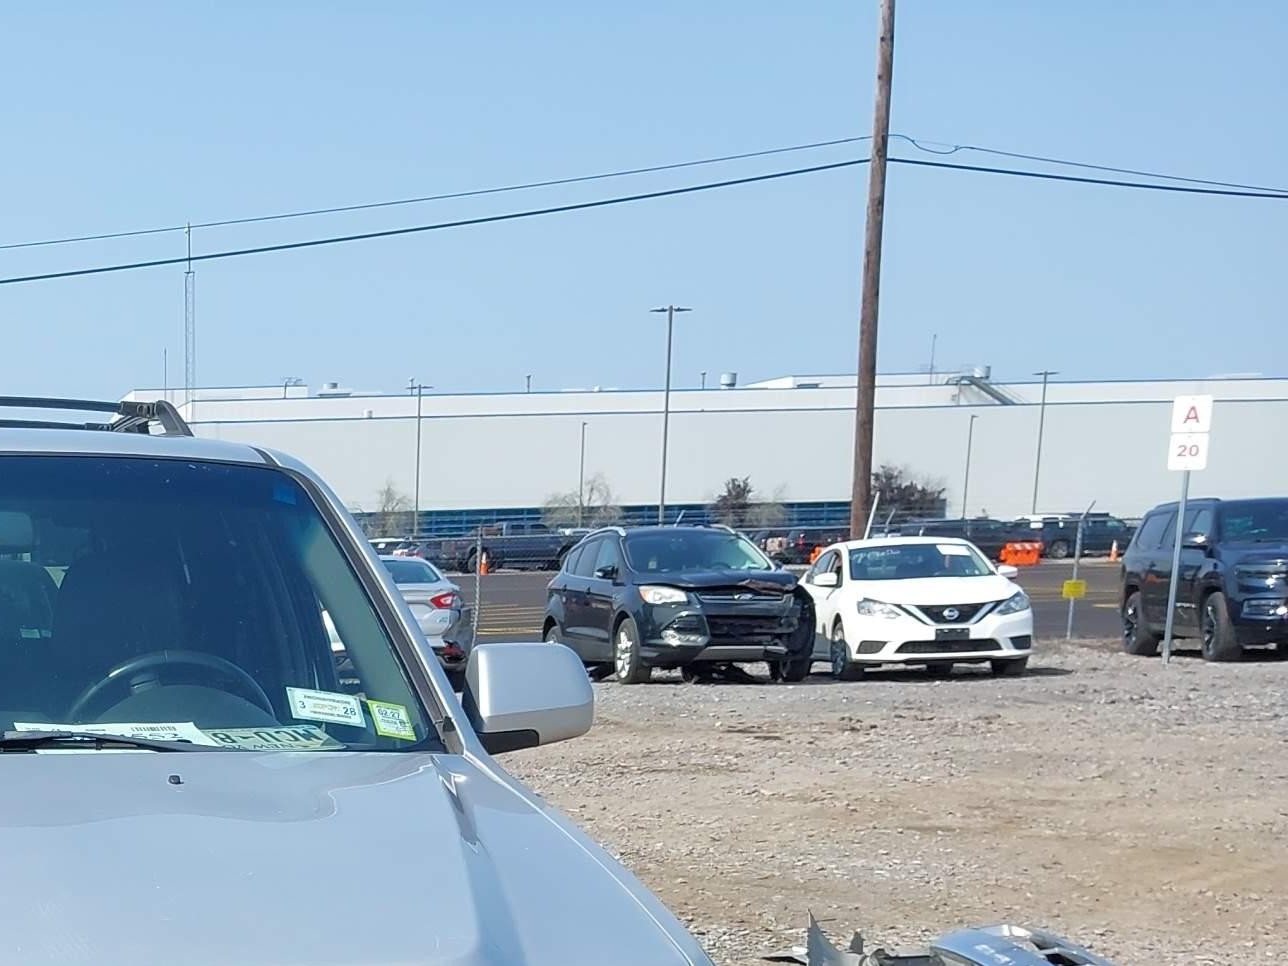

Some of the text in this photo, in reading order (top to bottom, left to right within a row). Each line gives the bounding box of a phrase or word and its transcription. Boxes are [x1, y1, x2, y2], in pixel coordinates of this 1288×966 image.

[1183, 405, 1200, 424] A
[1177, 444, 1200, 457] 20
[342, 706, 357, 716] 28
